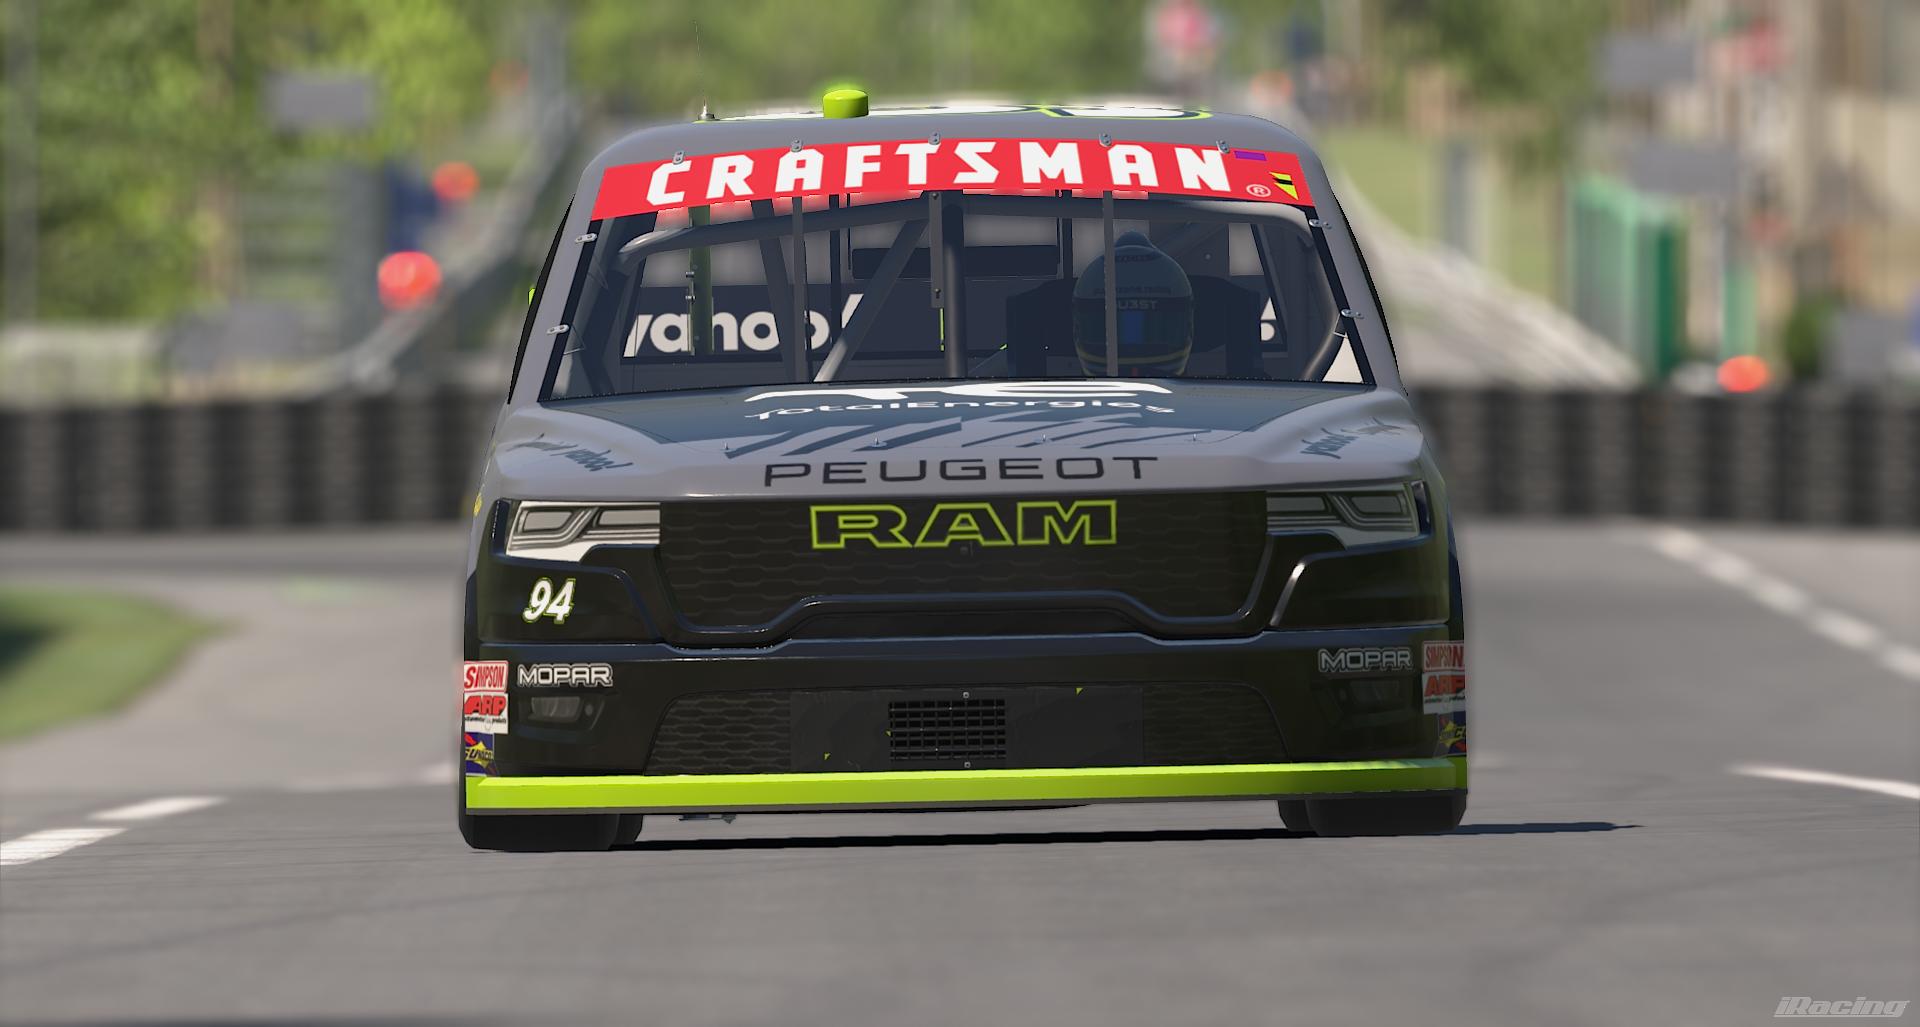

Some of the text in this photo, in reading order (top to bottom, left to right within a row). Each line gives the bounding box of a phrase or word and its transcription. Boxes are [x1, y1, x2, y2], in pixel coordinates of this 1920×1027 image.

[646, 141, 1231, 206] CRAFTSMAN
[745, 400, 1175, 420] TotalEnergies
[764, 457, 1158, 487] PEUGEOT
[810, 500, 1117, 549] RAM
[522, 577, 577, 625] 94
[1318, 648, 1413, 672] MOPAR
[464, 666, 505, 689] SIMPSON
[517, 663, 613, 687] MOPAR
[464, 695, 506, 716] ARP
